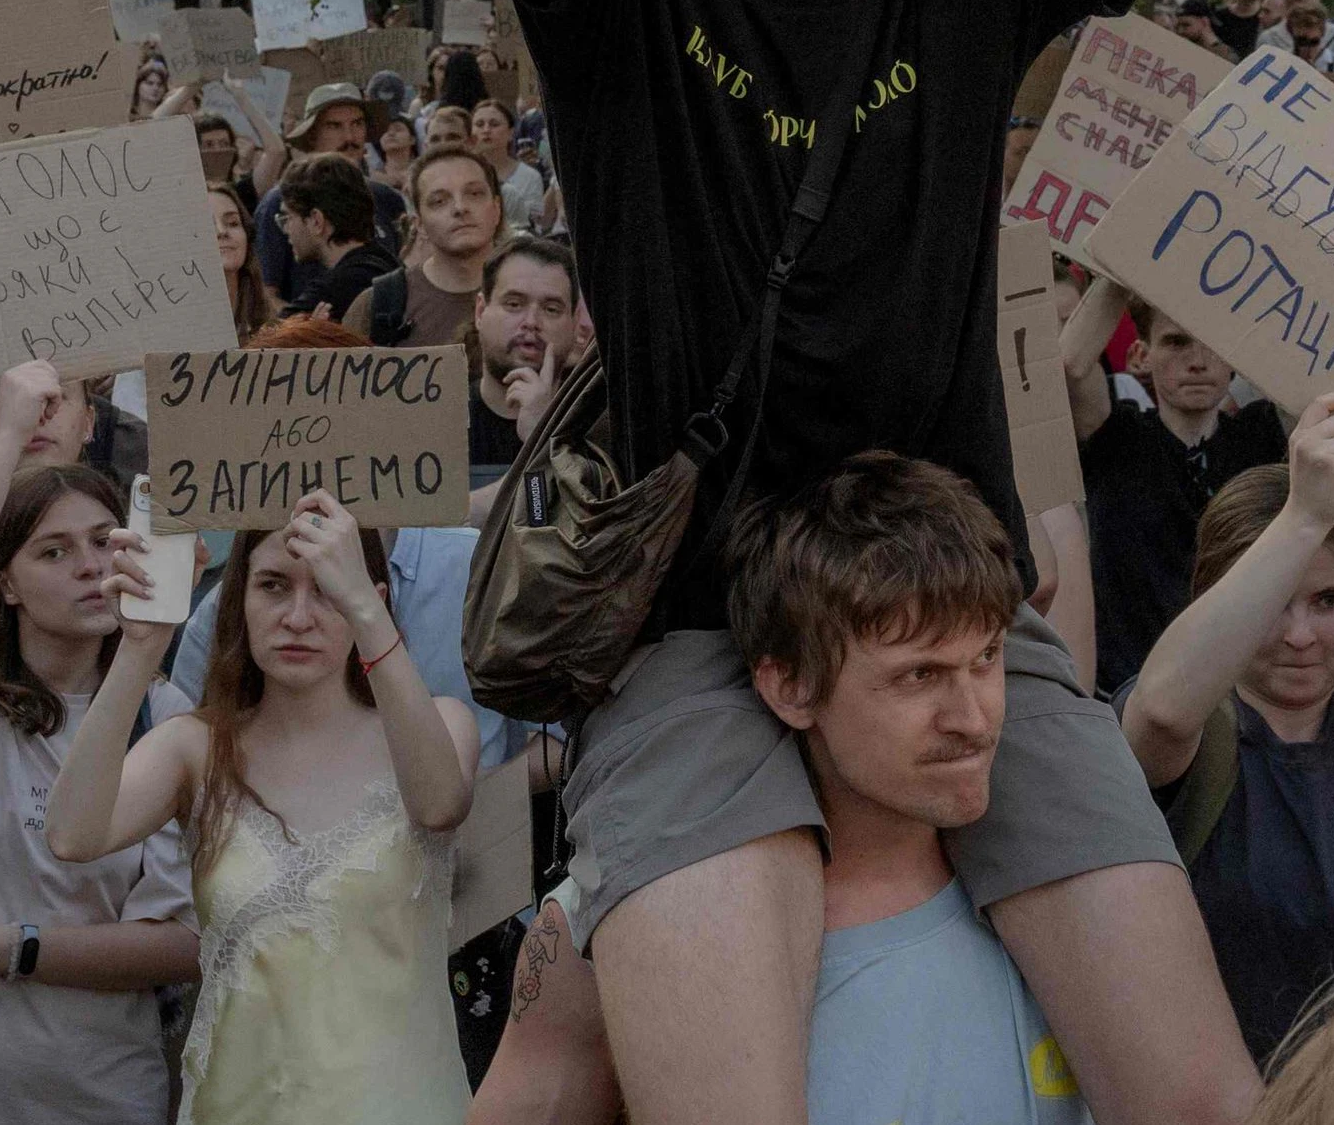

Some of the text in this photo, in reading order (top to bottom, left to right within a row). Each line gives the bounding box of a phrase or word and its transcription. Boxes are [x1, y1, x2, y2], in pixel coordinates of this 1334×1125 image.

[1064, 77, 1173, 146] МЕНЕ
[1238, 52, 1332, 123] НЕ
[260, 414, 332, 457] АБО
